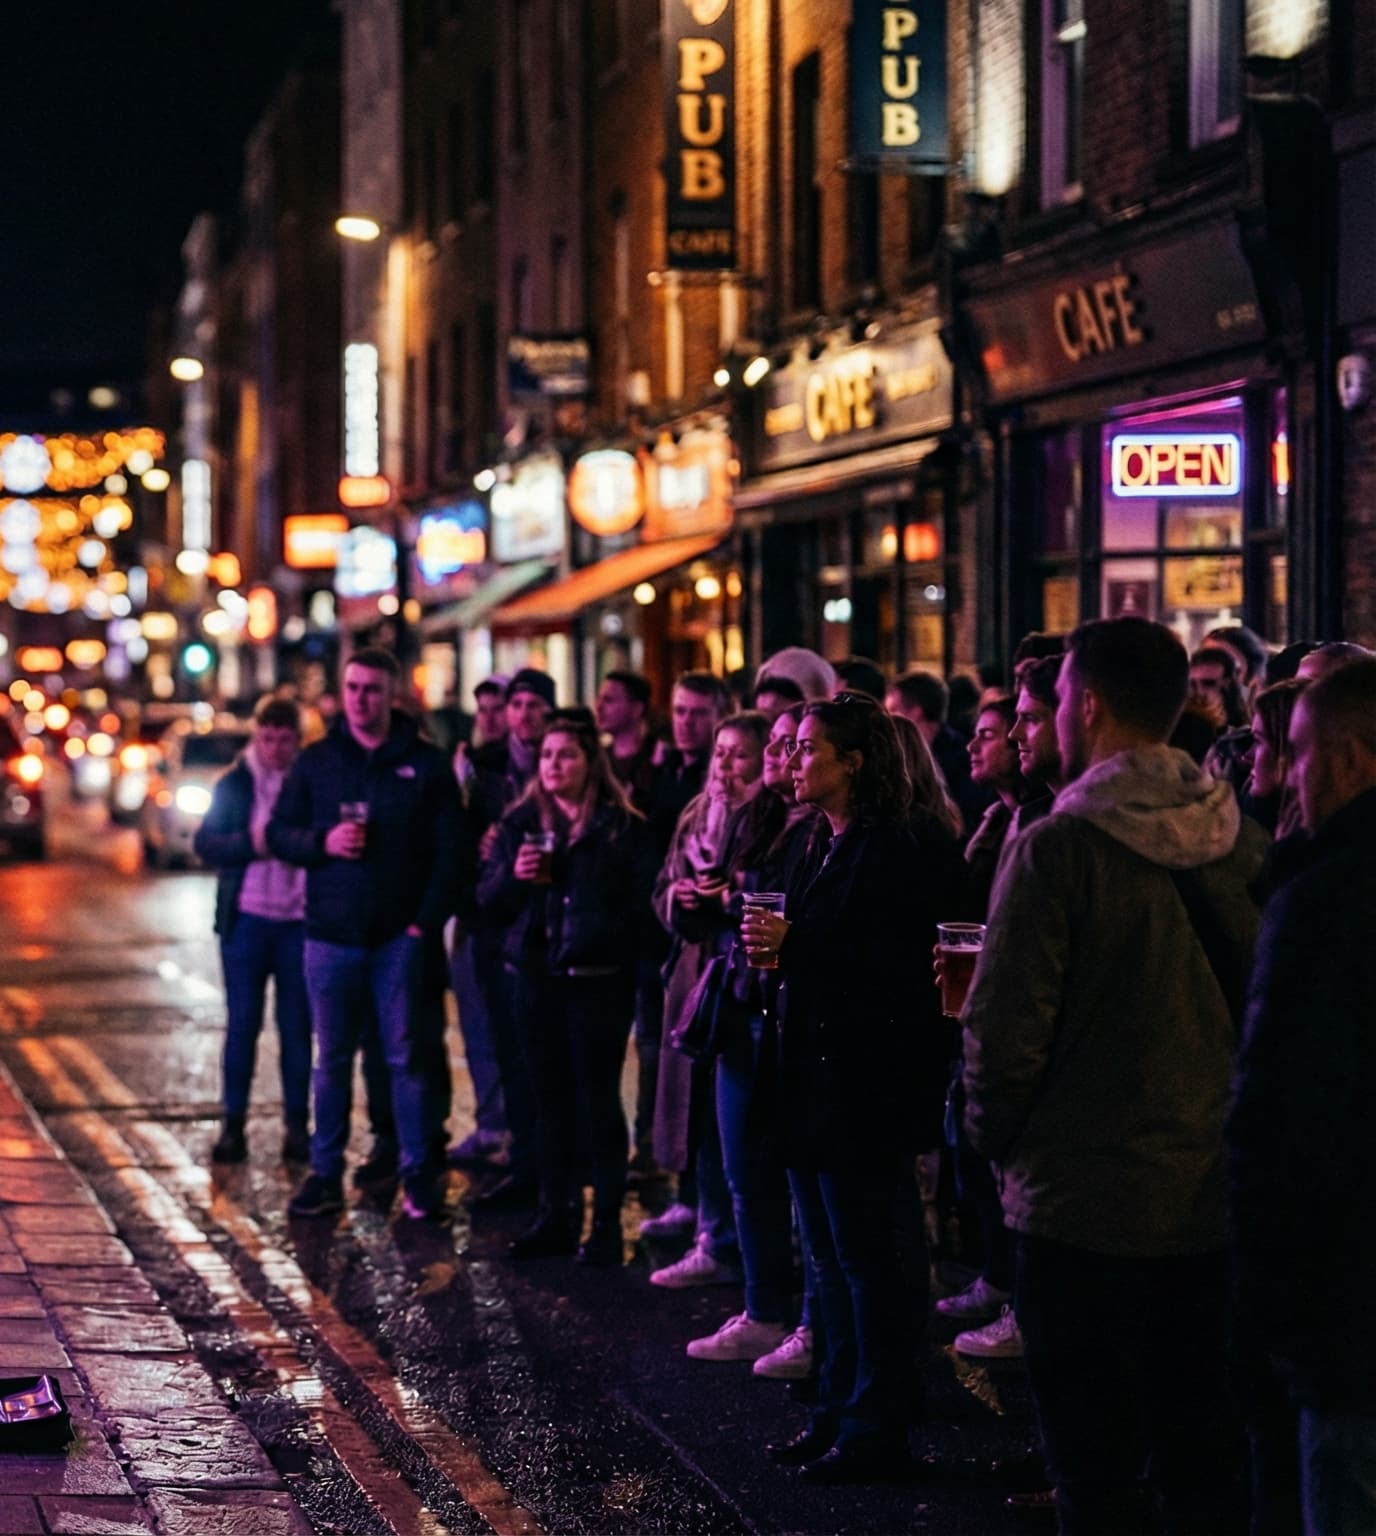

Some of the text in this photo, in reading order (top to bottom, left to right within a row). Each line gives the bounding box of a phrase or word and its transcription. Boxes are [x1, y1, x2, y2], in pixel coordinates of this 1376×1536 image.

[677, 38, 726, 199] PUB
[881, 8, 921, 146] PUB
[1122, 443, 1231, 486] OPEN
